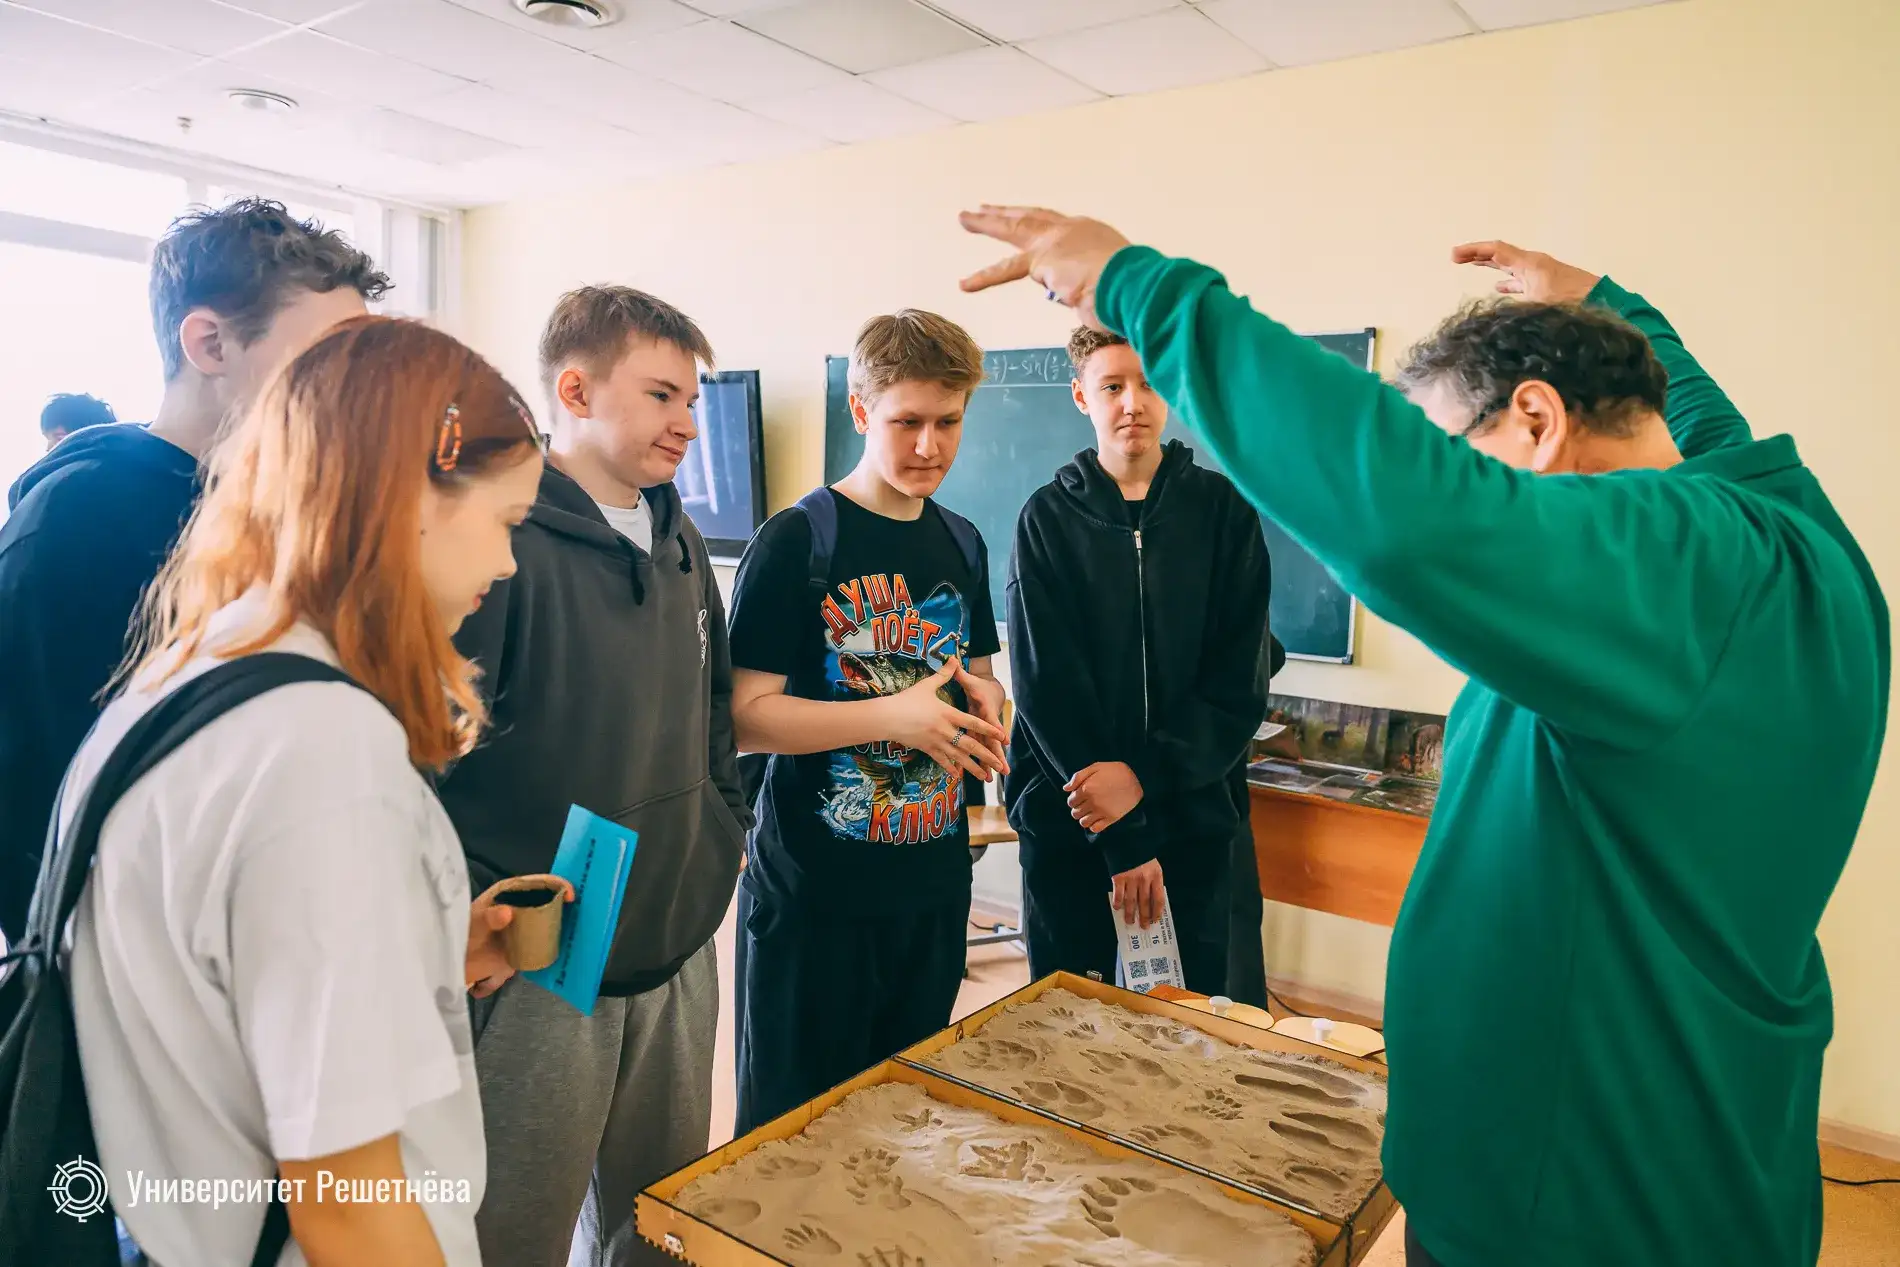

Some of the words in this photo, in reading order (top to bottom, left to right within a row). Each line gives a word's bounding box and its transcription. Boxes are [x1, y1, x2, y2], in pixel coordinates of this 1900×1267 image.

[821, 573, 913, 648] ДУША
[871, 608, 942, 660] ПОЁТ
[866, 769, 963, 845] КЛЮЁ
[1131, 935, 1140, 950] 300
[1151, 935, 1160, 945] 16
